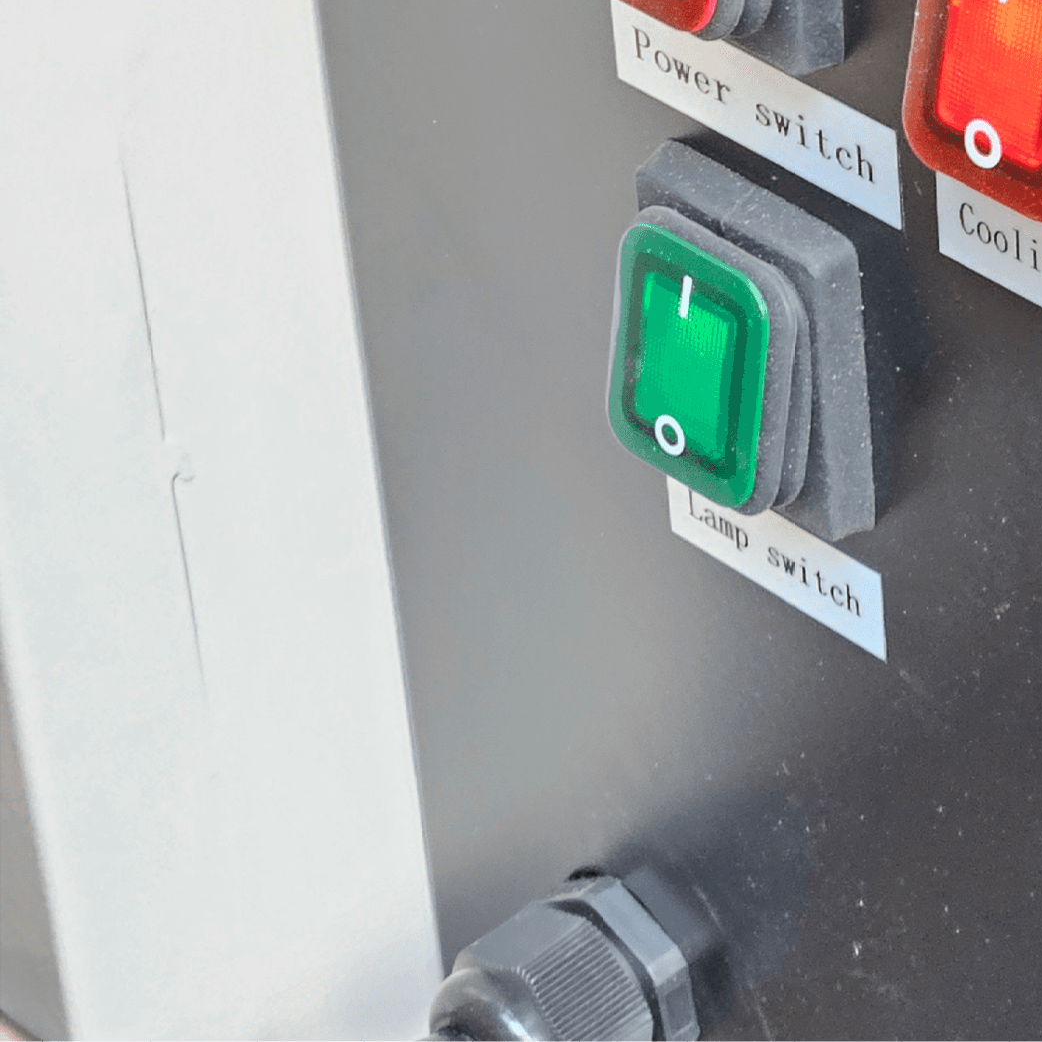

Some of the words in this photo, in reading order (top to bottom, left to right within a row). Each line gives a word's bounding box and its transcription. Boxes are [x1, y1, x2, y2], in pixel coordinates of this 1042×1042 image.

[631, 25, 731, 105] Power
[754, 102, 876, 185] switch
[686, 486, 749, 552] Lamp
[766, 546, 861, 618] switch
